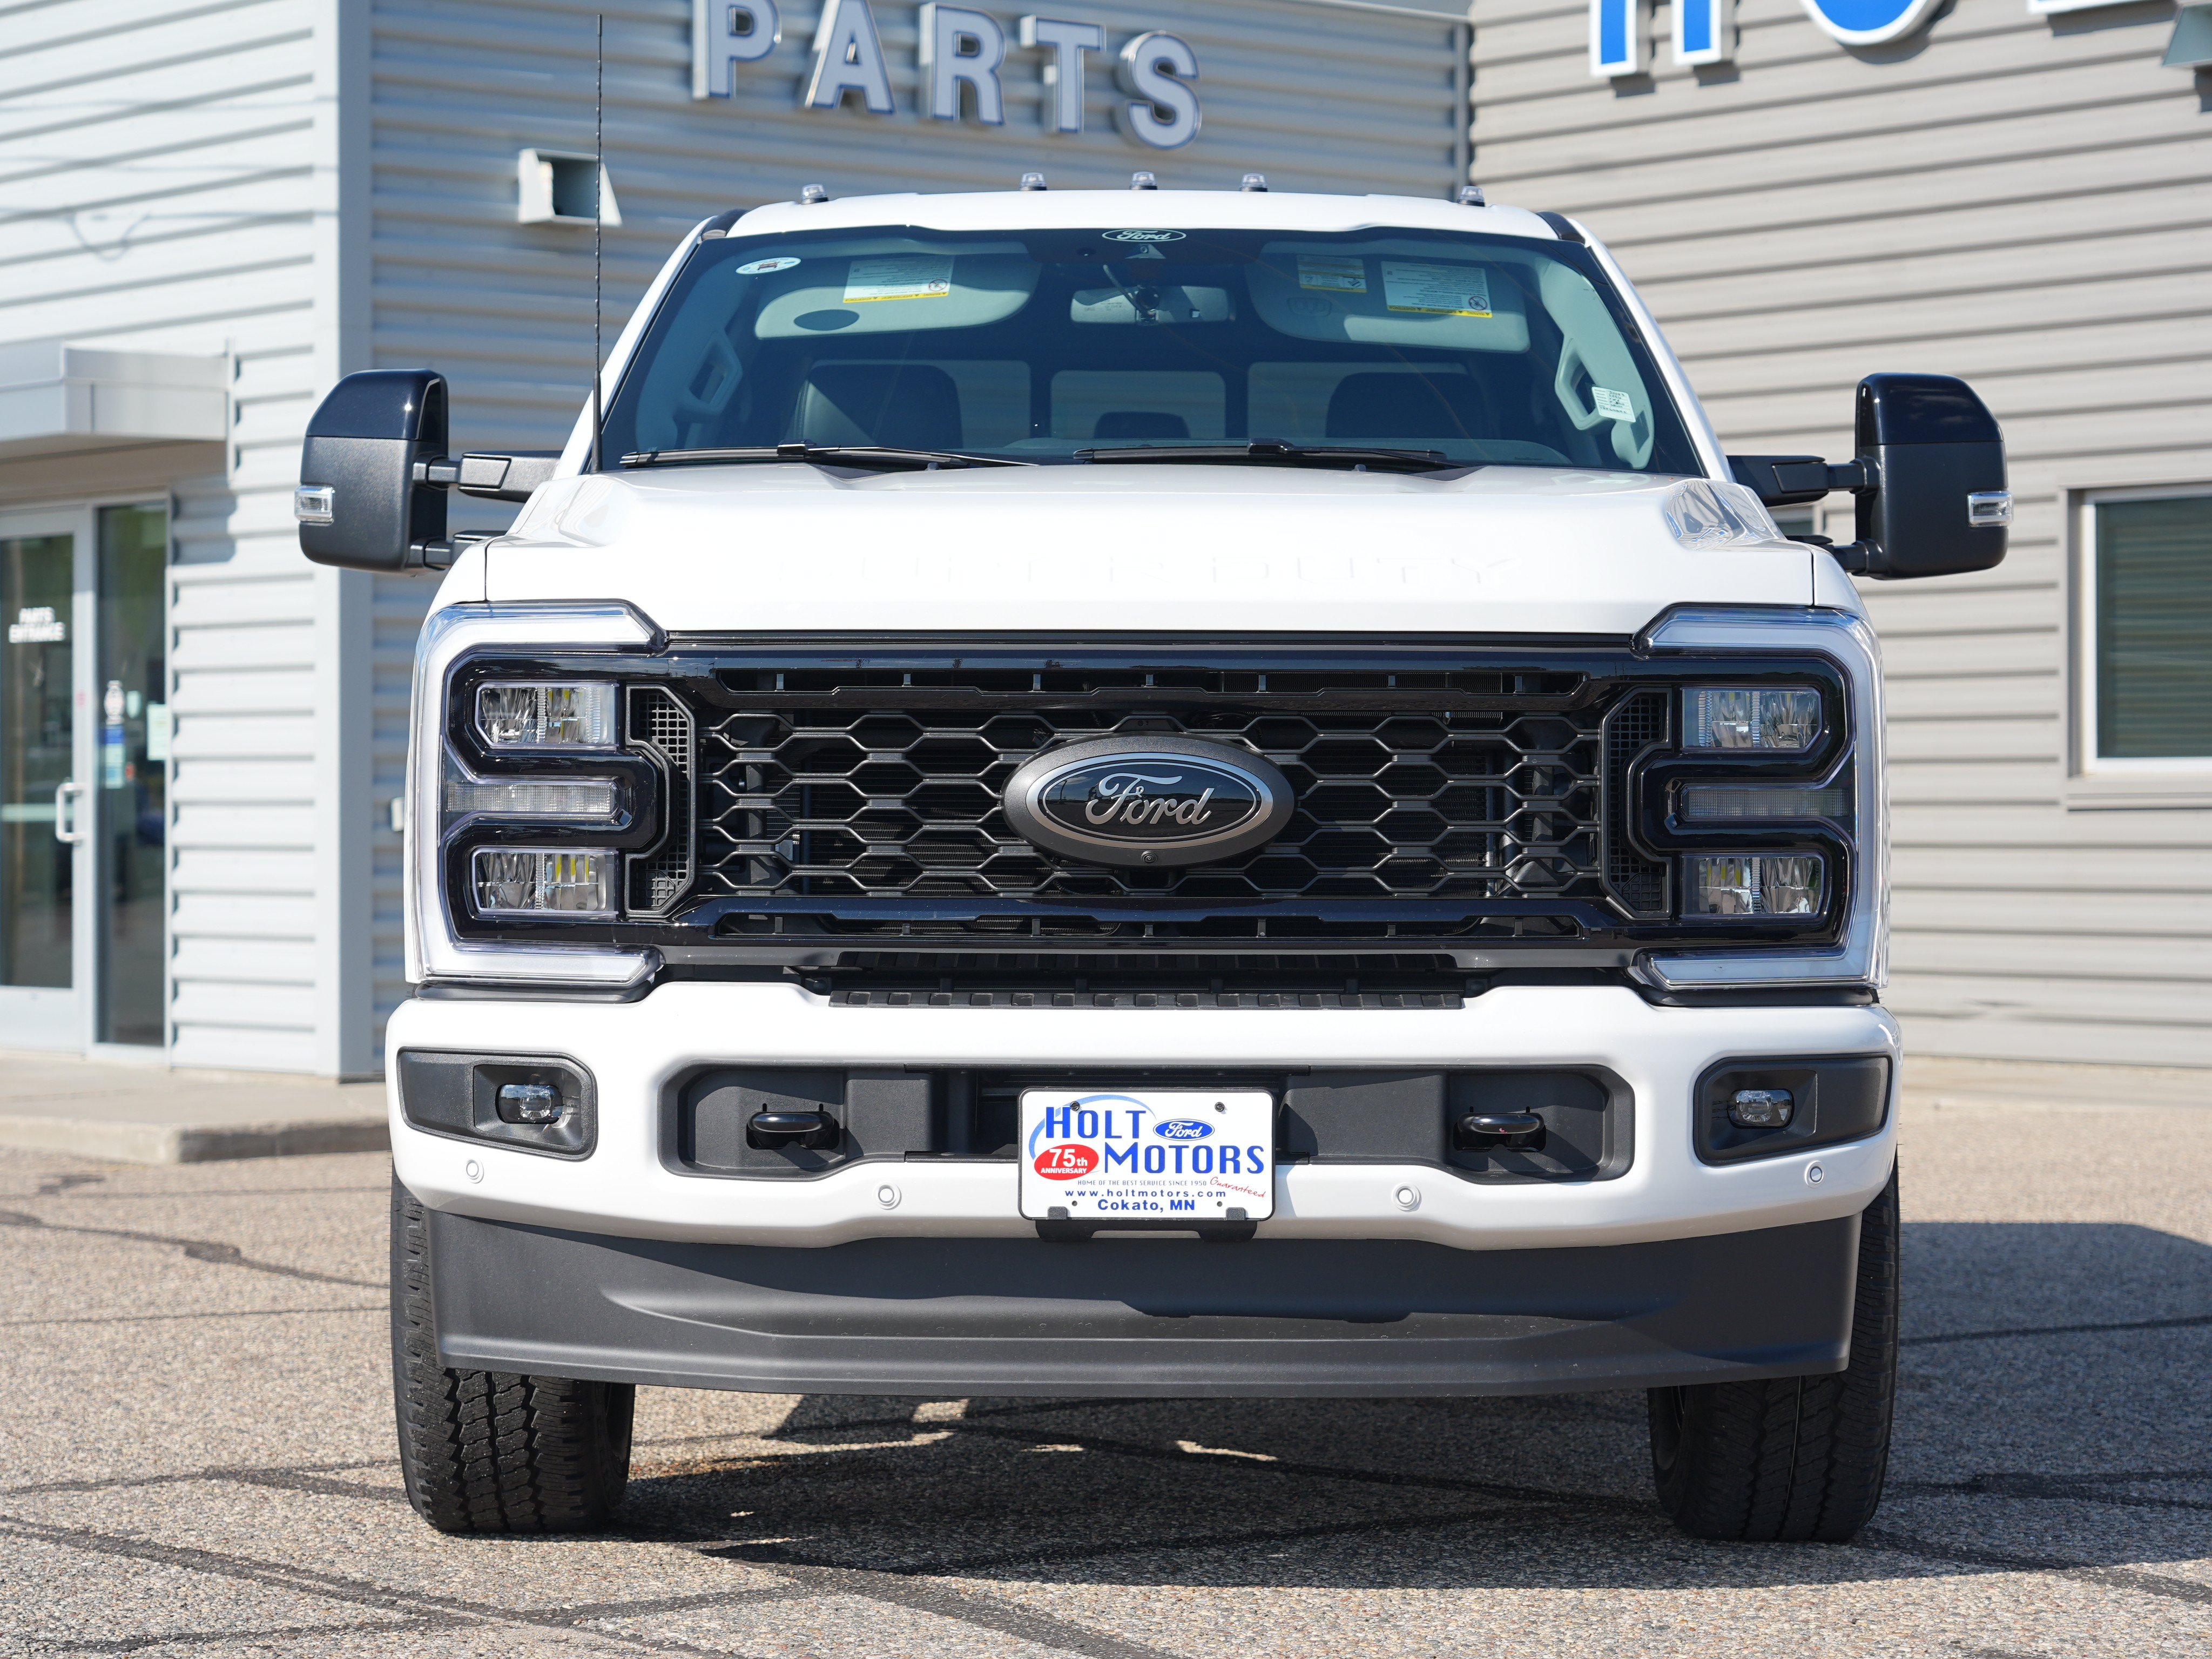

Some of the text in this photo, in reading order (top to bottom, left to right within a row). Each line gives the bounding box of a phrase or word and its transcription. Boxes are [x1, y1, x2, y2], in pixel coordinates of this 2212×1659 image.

[693, 0, 1202, 150] PARTS
[1116, 230, 1172, 240] Ford
[1085, 772, 1215, 825] Ford
[1046, 1106, 1147, 1139] HOLT
[1164, 1121, 1203, 1138] Ford
[1049, 1149, 1088, 1167] 75th
[1104, 1142, 1264, 1174] MOTORS
[1064, 1189, 1226, 1197] www.holtmotors.com
[1210, 1176, 1266, 1198] Guaranteed
[1097, 1199, 1195, 1213] Cokato, MN
